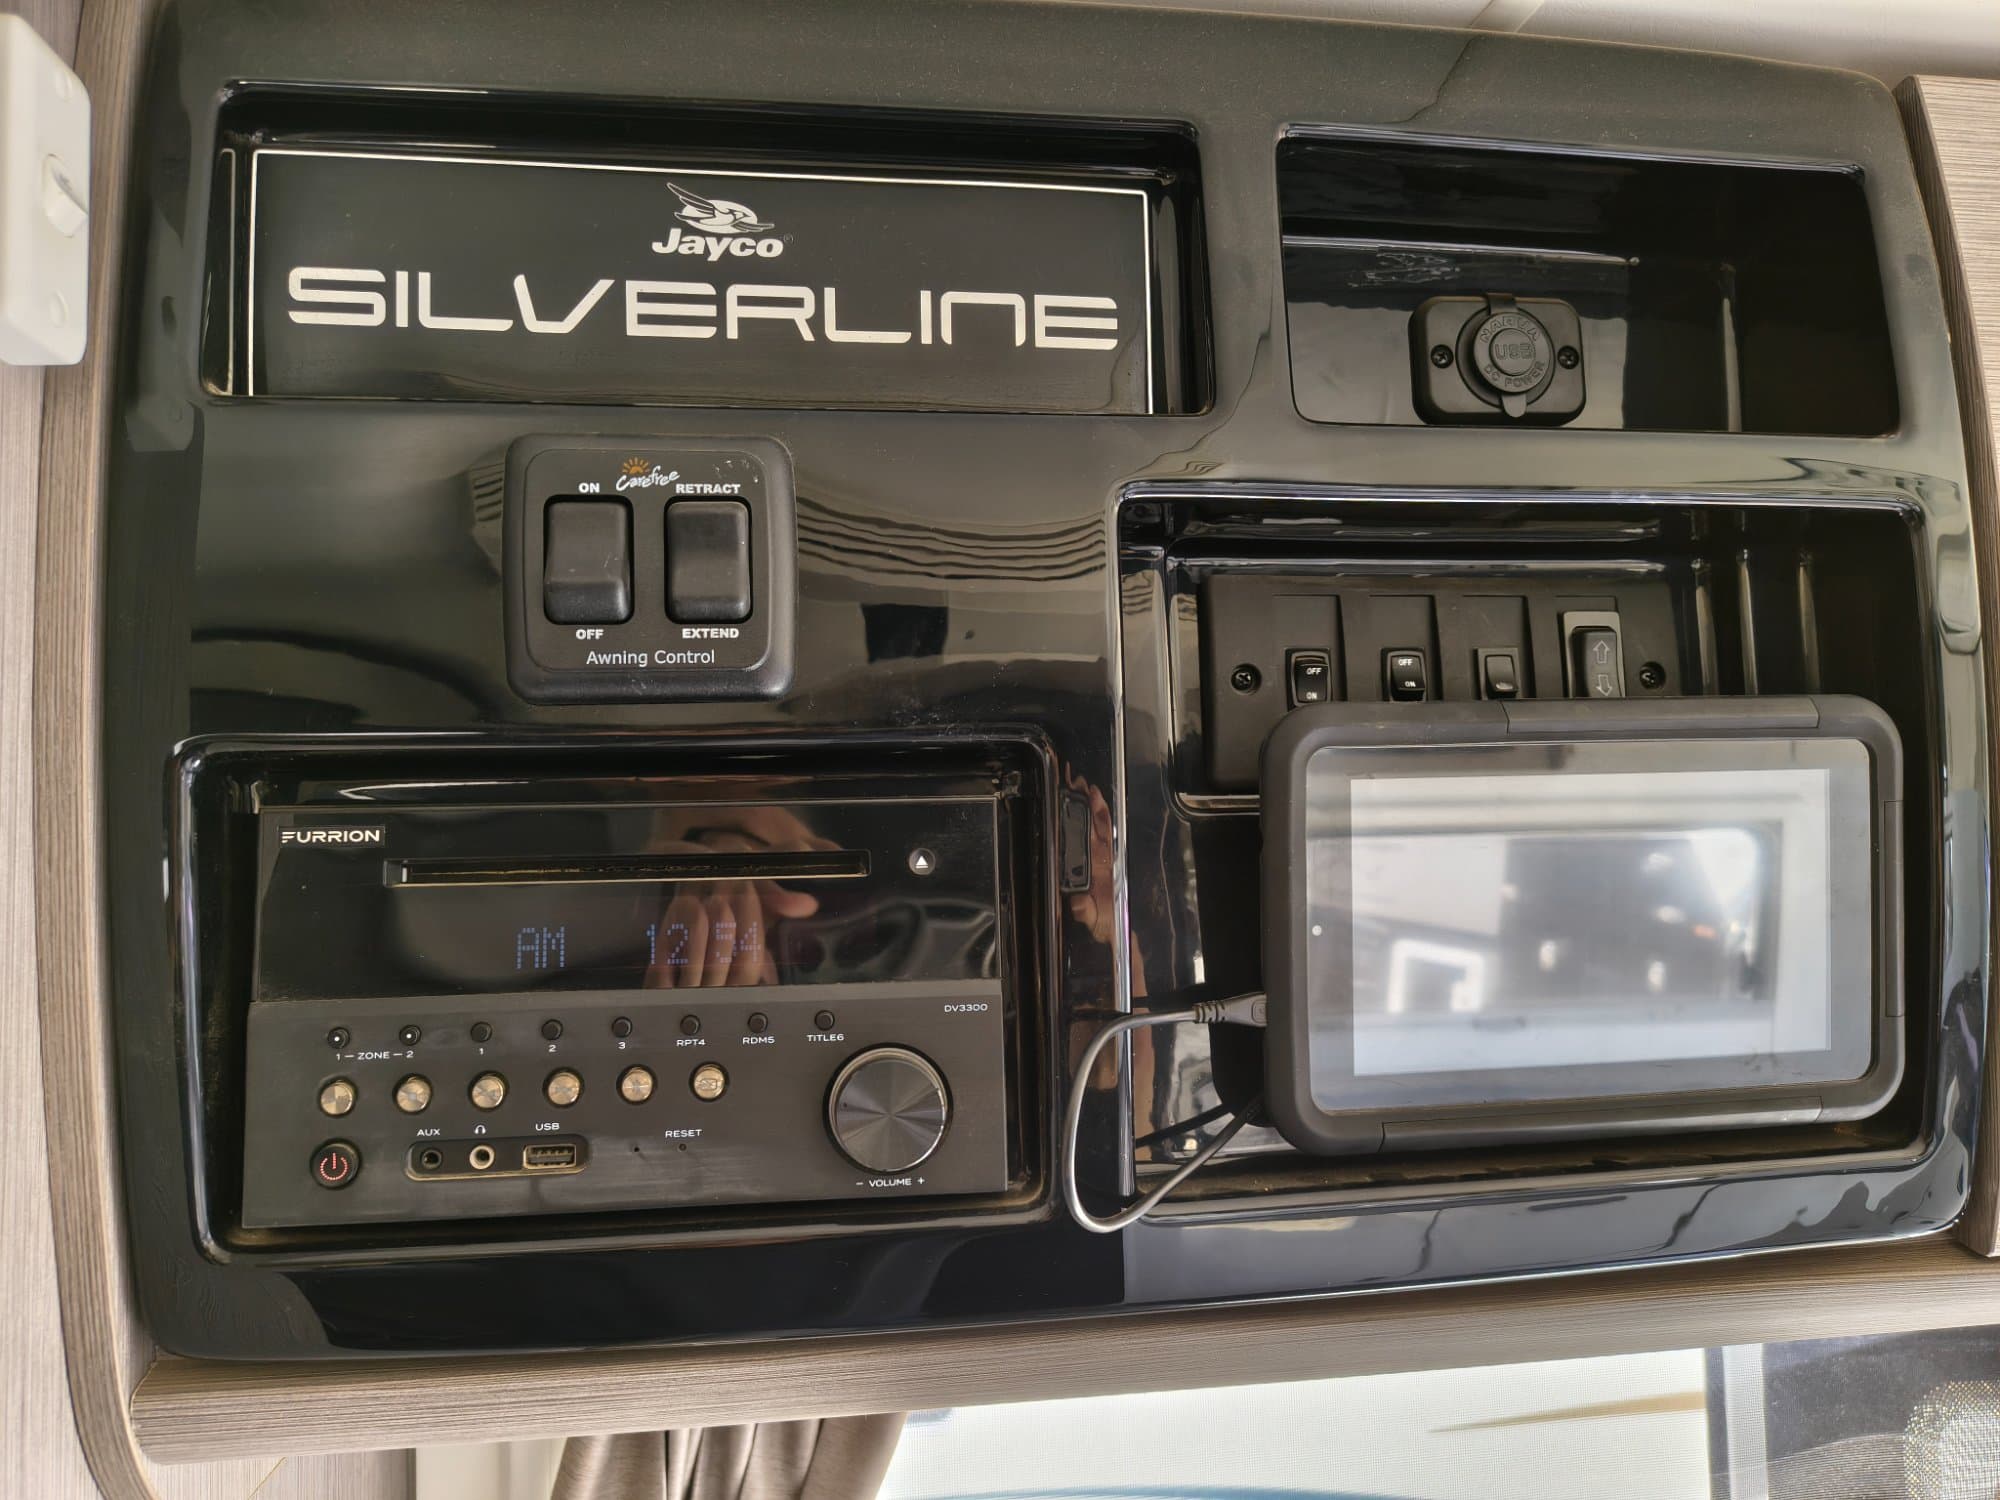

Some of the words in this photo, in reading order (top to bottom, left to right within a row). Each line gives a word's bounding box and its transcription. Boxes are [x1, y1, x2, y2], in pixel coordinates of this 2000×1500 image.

[651, 228, 784, 262] Jayco
[287, 265, 1118, 350] SILVERLINE
[1494, 343, 1536, 361] USB
[615, 465, 681, 492] Carefree
[578, 482, 600, 493] ON
[675, 483, 741, 494] RETRACT
[575, 629, 604, 640] OFF
[682, 628, 739, 639] EXTEND
[586, 651, 648, 667] Awning
[654, 650, 715, 665] Control
[1398, 658, 1413, 666] OFF
[1306, 667, 1322, 675] OFF
[1306, 691, 1317, 699] ON
[281, 830, 380, 843] FURRION
[517, 926, 565, 969] AM
[944, 1003, 988, 1013] DV3300
[676, 1038, 706, 1047] RPT4
[742, 1036, 776, 1045] RDM5
[807, 1033, 845, 1042] TITLE6
[548, 1044, 556, 1053] 2
[618, 1041, 626, 1050] 3
[535, 1122, 560, 1132] USB
[416, 1128, 441, 1137] AUX
[665, 1128, 702, 1138] RESET
[868, 1177, 912, 1187] VOLUME
